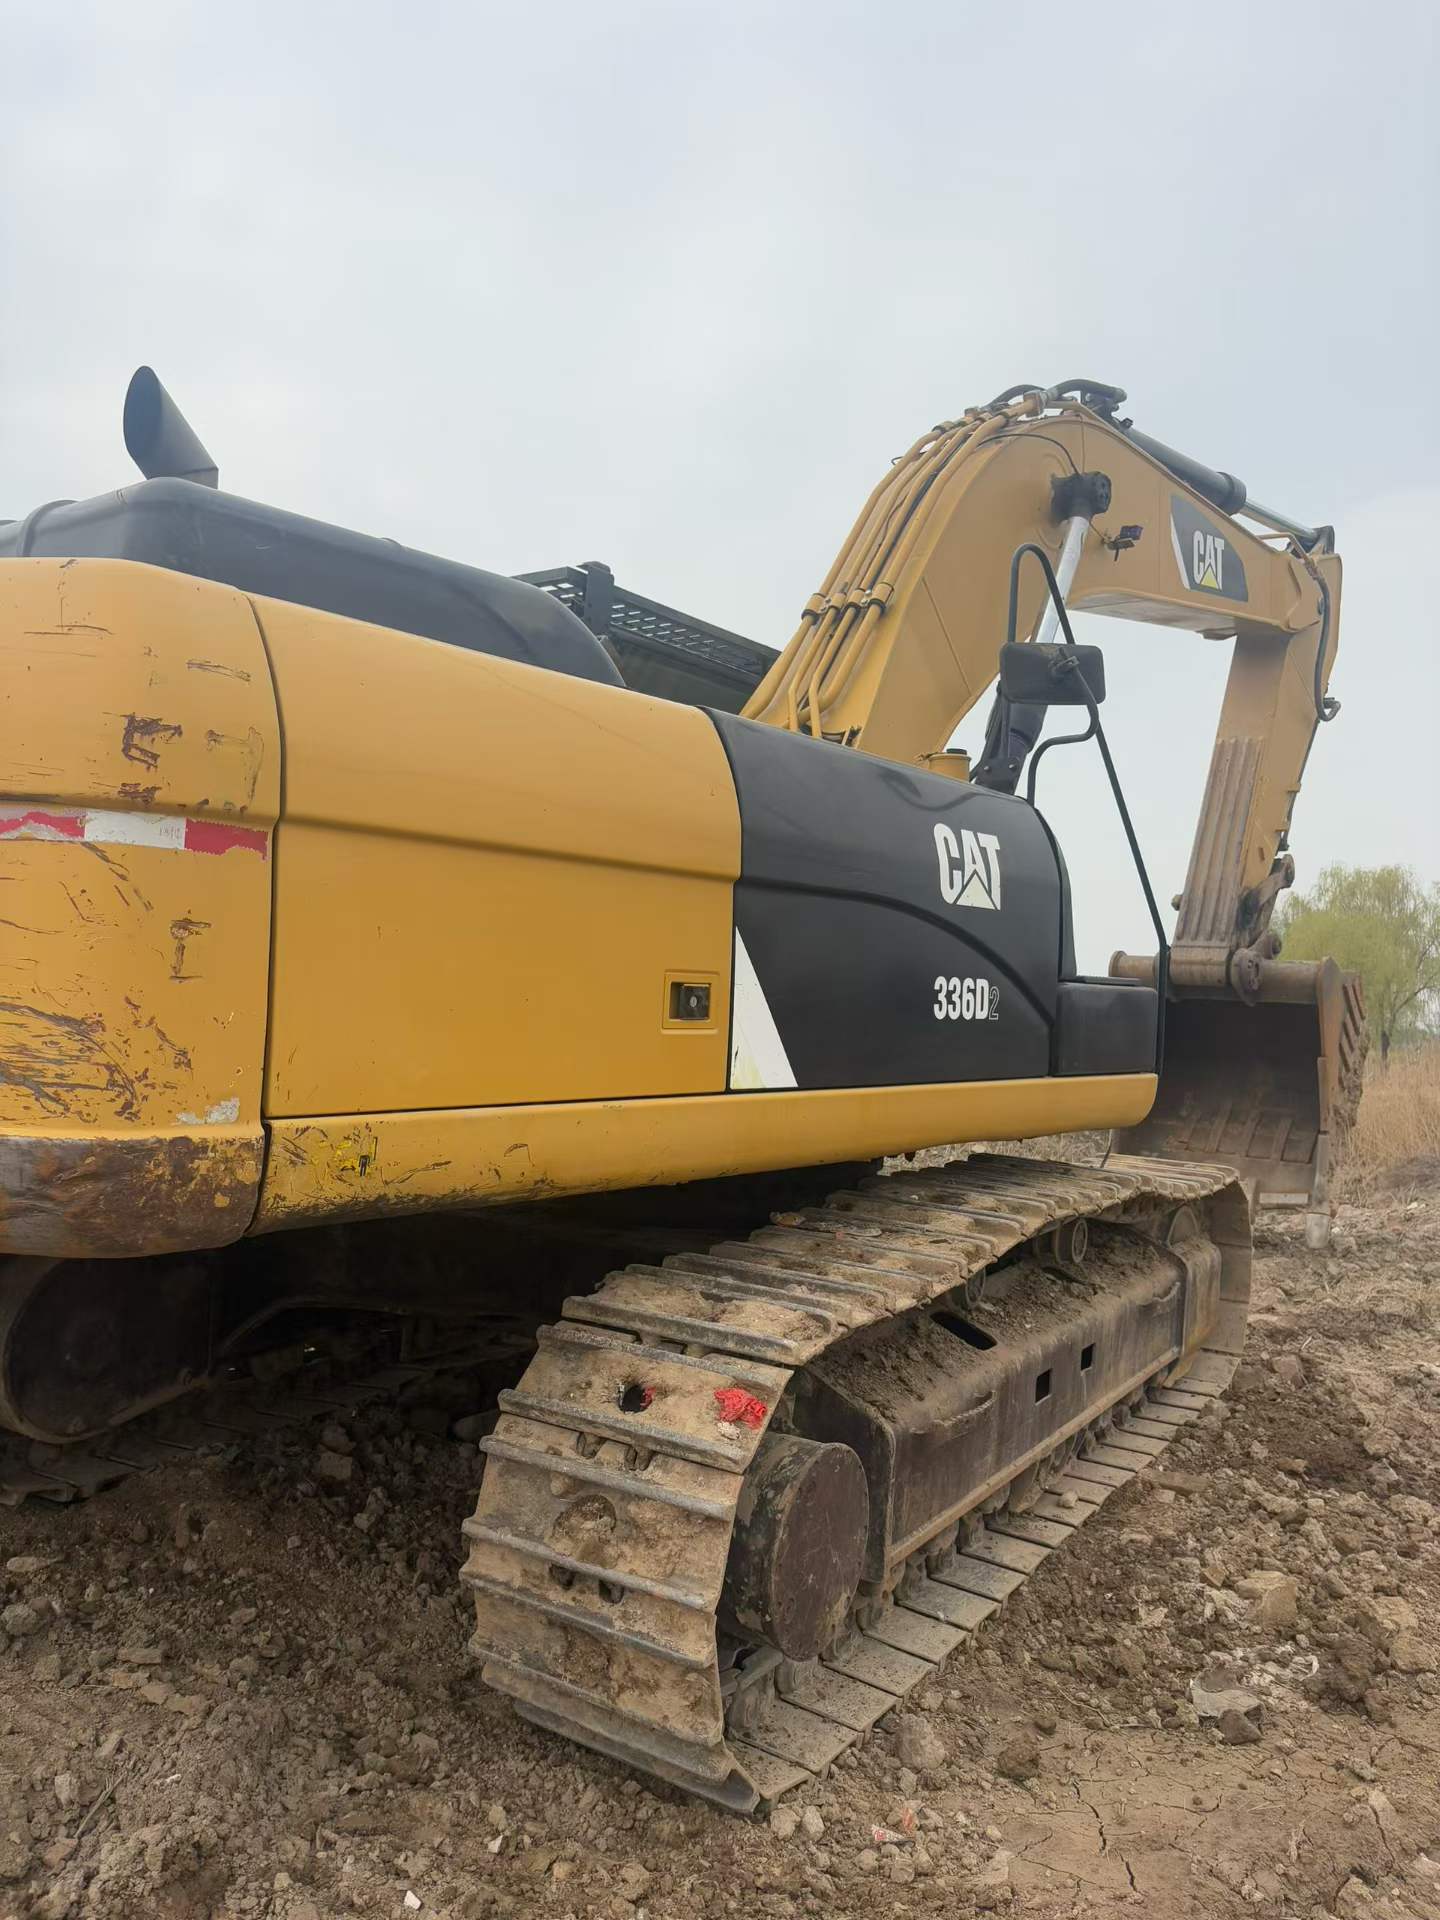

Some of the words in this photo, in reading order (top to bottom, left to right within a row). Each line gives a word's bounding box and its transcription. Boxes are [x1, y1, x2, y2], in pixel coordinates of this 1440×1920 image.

[1193, 530, 1225, 592] CAT
[933, 823, 1001, 911] CAT
[933, 976, 1000, 1021] 336D2
